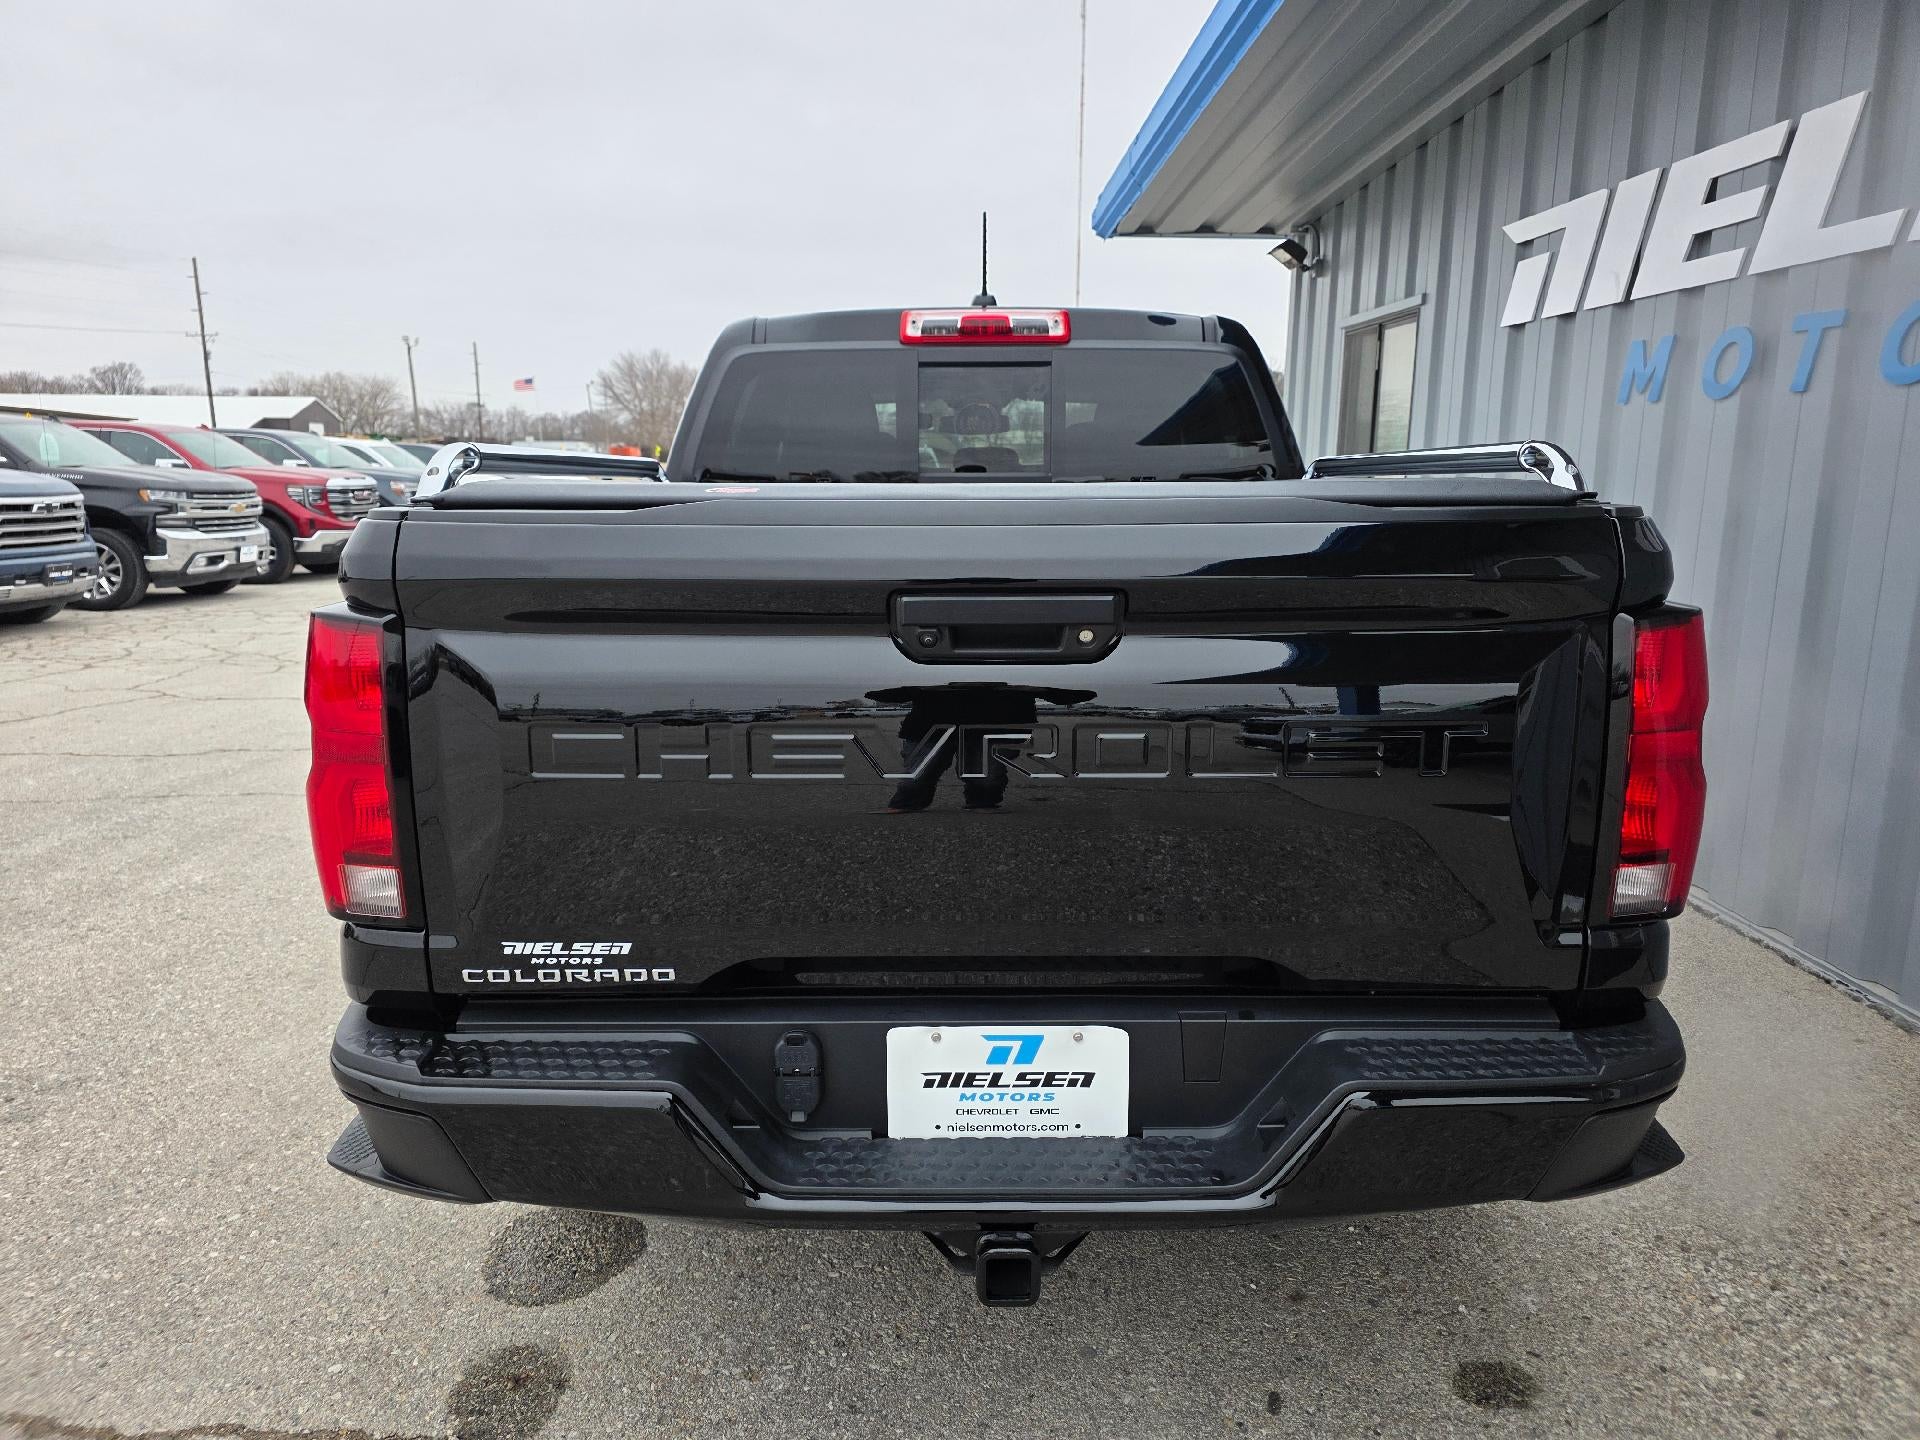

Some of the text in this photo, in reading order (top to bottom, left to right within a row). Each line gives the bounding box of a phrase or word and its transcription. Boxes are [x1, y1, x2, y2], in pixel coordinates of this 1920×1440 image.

[1500, 90, 1920, 327] NIEL
[527, 720, 1489, 779] CHEVROLET
[501, 941, 632, 954] NIELSEN
[462, 969, 675, 982] COLORADO
[921, 1072, 1096, 1088] NIELSEN
[958, 1092, 1056, 1102] MOTORS
[955, 1108, 1020, 1116] CHEVROLET
[947, 1122, 1069, 1132] nielsenmotors.com
